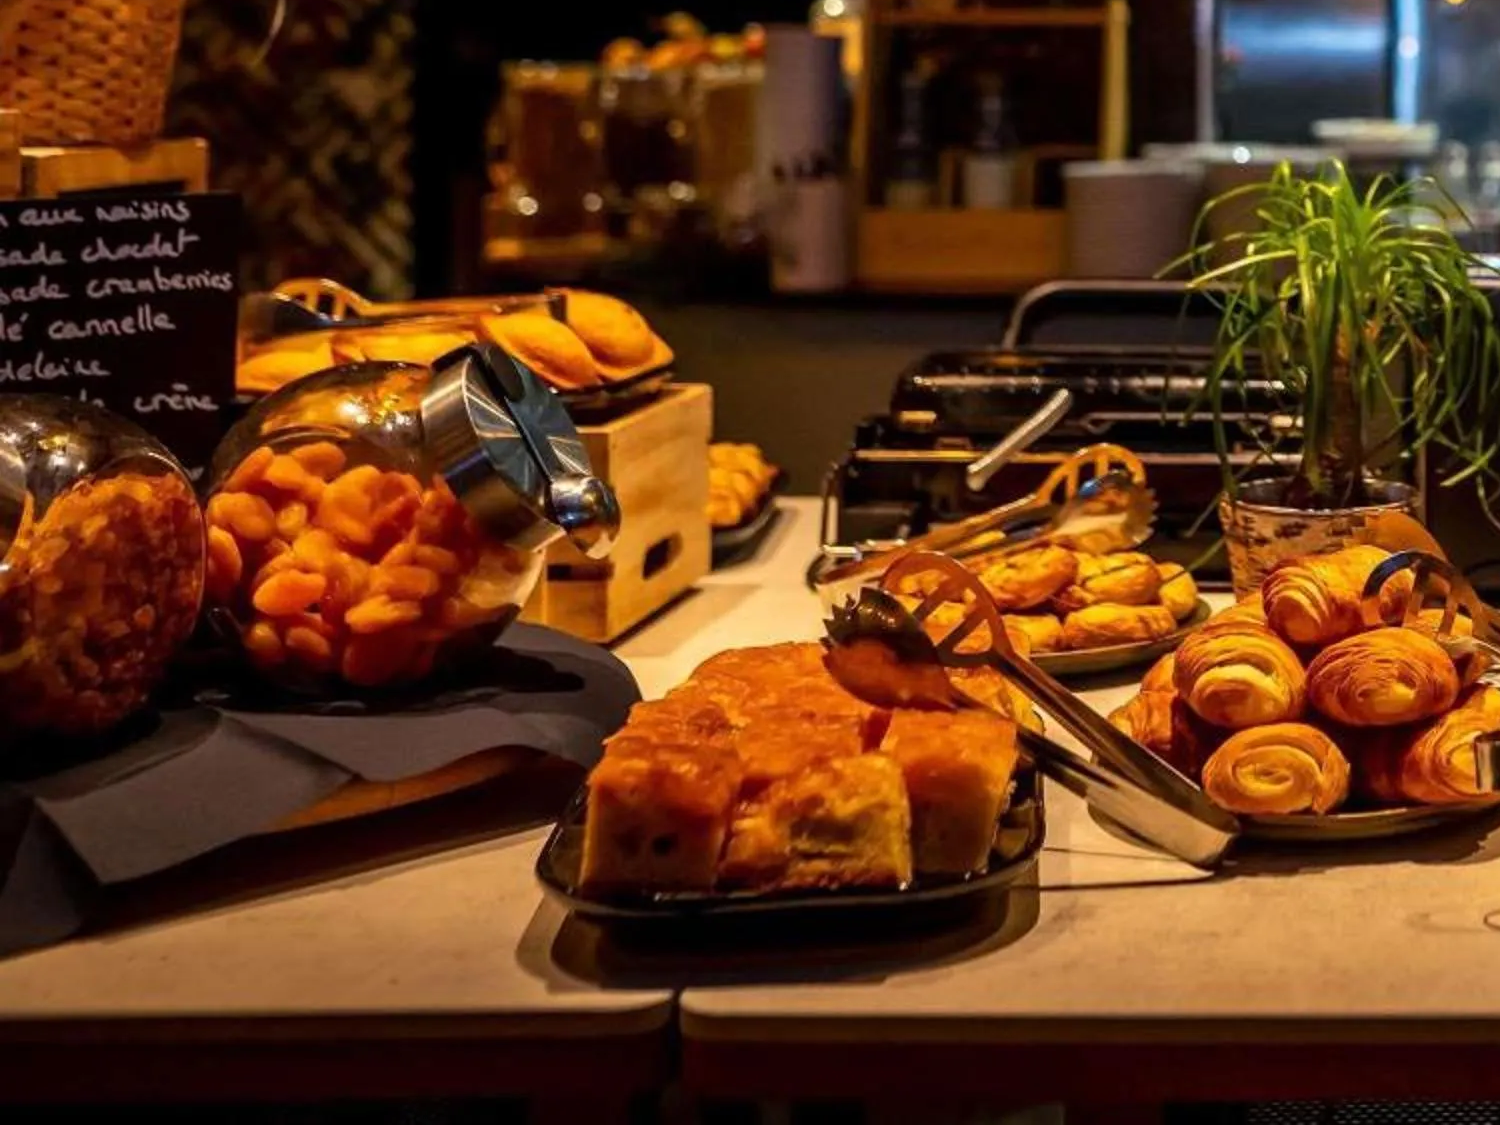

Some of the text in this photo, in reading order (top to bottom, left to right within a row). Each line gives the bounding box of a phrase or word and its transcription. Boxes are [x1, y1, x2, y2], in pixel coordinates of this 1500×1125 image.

[18, 207, 84, 227] aux
[95, 199, 191, 223] raisins
[80, 227, 200, 264] chocolat
[86, 264, 234, 299] cranberries
[48, 303, 176, 340] cannelle
